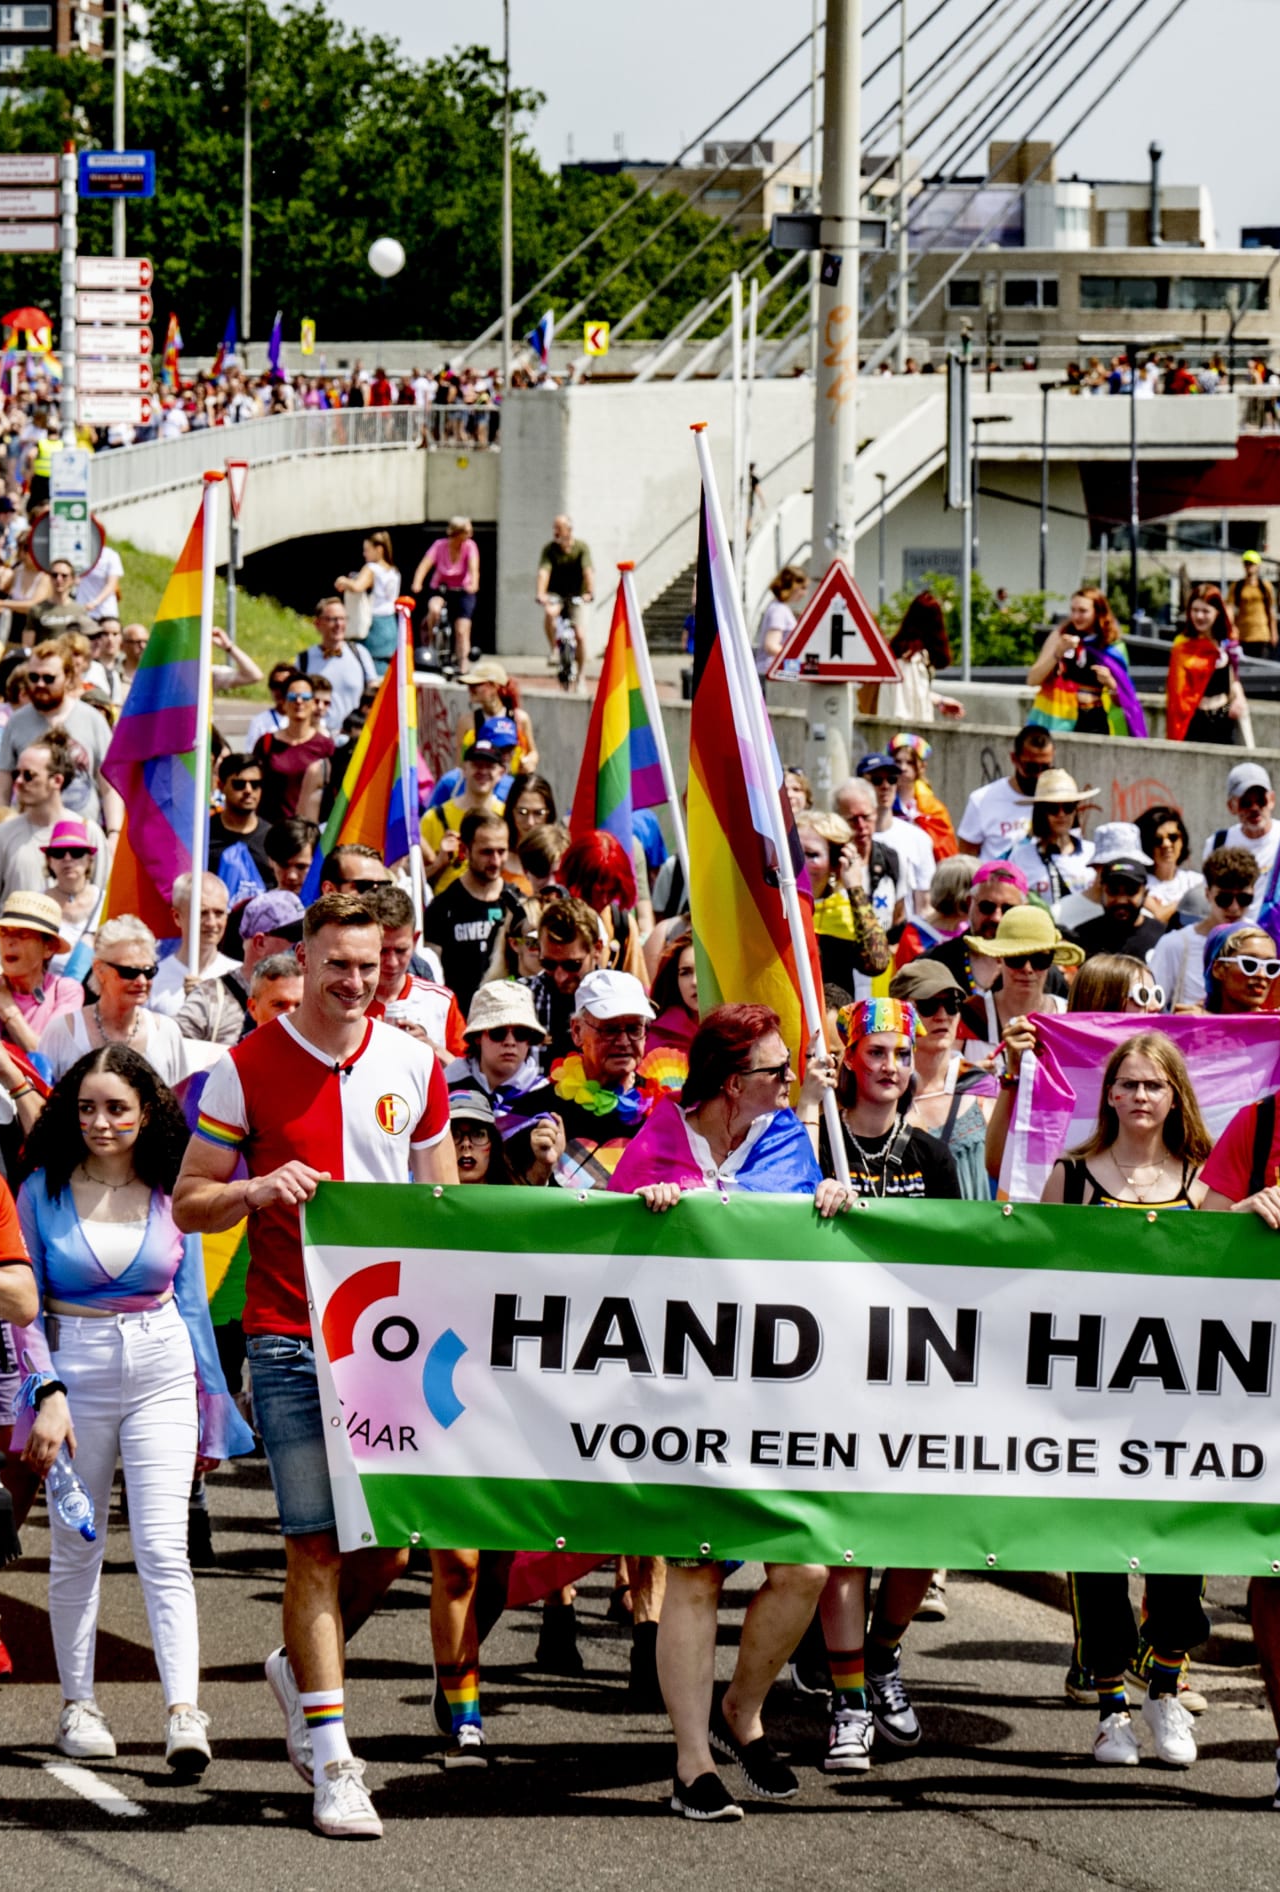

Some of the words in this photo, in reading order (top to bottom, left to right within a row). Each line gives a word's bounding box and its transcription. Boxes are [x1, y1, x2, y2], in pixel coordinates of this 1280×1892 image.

[490, 1293, 821, 1380] HAND
[867, 1307, 979, 1383] IN
[570, 1422, 729, 1464] VOOR
[750, 1430, 858, 1468] EEN
[879, 1434, 1097, 1474] VEILIGE
[1119, 1439, 1266, 1479] STAD
